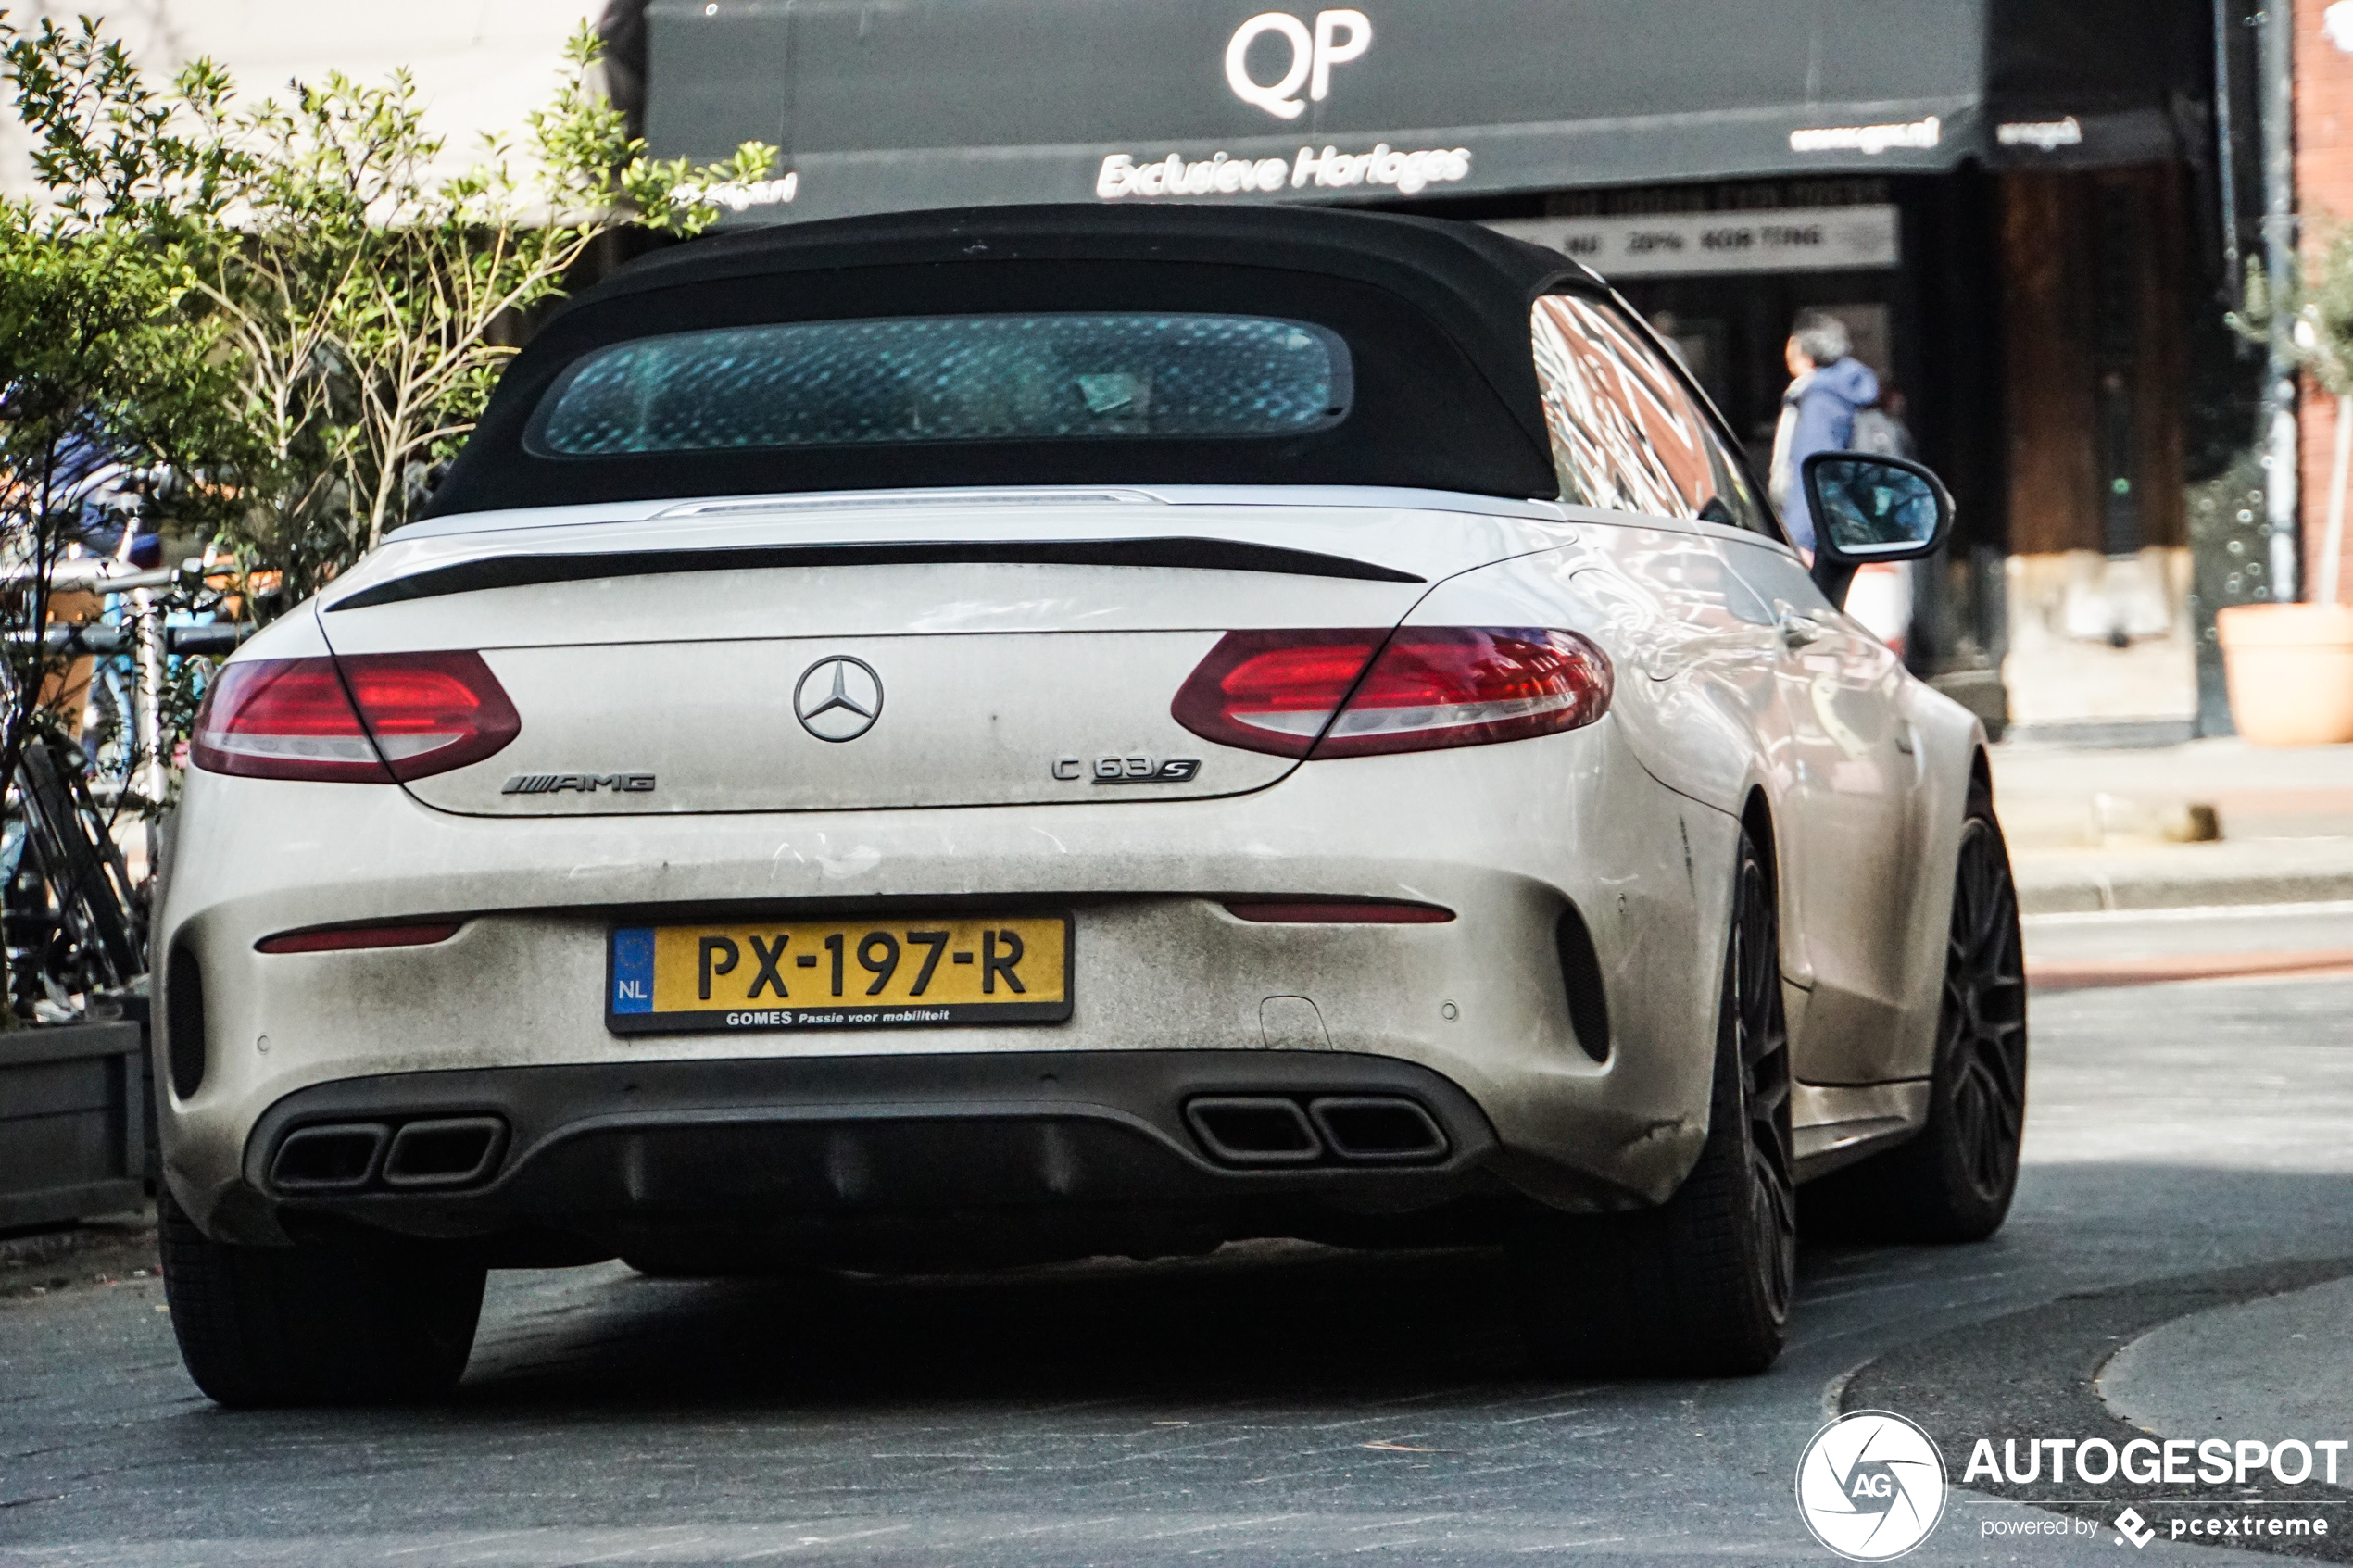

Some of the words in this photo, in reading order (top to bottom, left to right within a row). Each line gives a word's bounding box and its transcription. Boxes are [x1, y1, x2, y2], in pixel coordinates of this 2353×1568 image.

[1226, 9, 1372, 119] QP
[1096, 151, 1289, 199] Exclusieve
[1291, 143, 1471, 194] Horloges
[618, 980, 648, 999] NL
[698, 928, 1026, 1000] PX-197-R
[726, 1011, 792, 1025] GOMES
[798, 1012, 844, 1024] Passie
[848, 1013, 879, 1022] voor
[882, 1010, 950, 1022] mobiliteit
